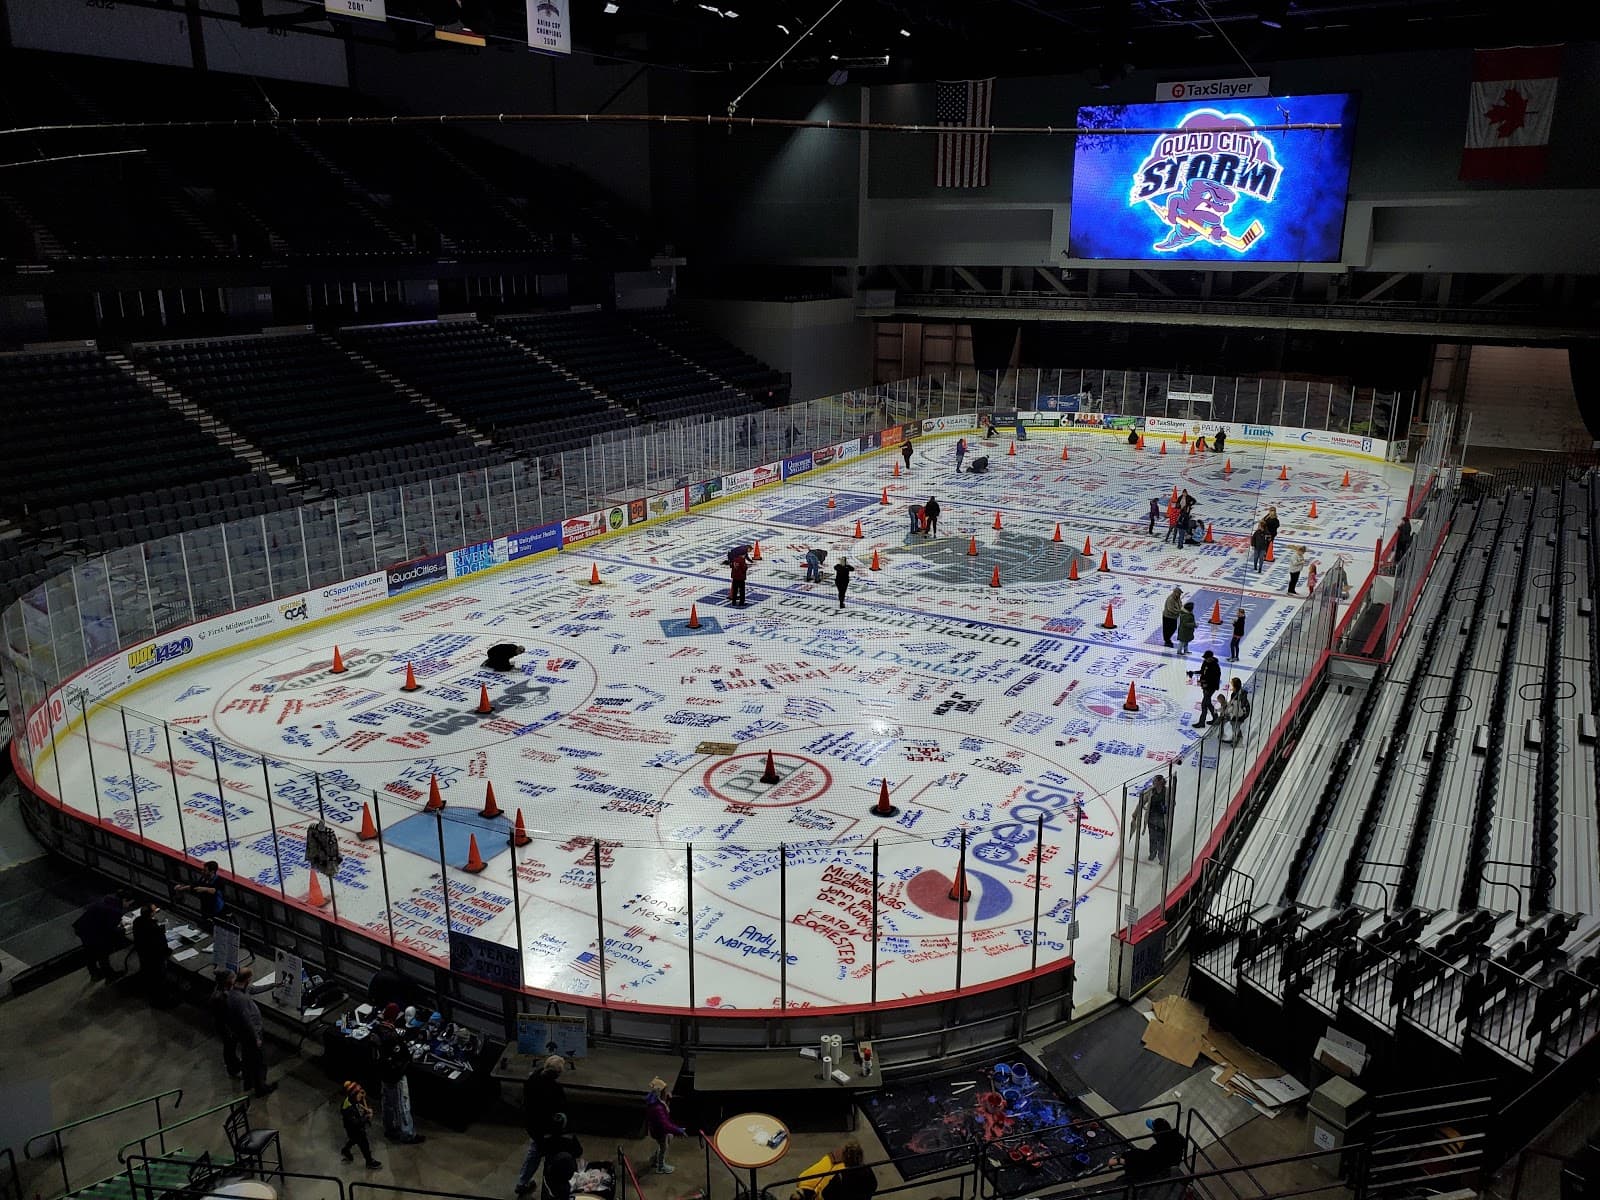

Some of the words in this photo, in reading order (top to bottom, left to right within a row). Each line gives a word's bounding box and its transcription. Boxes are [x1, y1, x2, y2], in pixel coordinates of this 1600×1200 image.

[1187, 82, 1252, 98] TaxSlayer
[1162, 133, 1213, 156] QUAD
[1219, 133, 1260, 162] CITY
[1138, 154, 1278, 198] STORM
[1201, 424, 1231, 435] PALMER
[1241, 425, 1275, 438] Times
[756, 606, 830, 628] Trinity
[774, 597, 922, 631] UnityPoint
[922, 623, 1022, 648] Health
[869, 649, 975, 679] Dental
[322, 769, 360, 792] BRAD
[972, 780, 1077, 873] pepsi
[398, 901, 433, 919] ELDON
[413, 897, 443, 913] EARL
[455, 902, 497, 921] MENKEN
[464, 896, 506, 914] MENKEN
[805, 907, 860, 937] KEATON
[401, 934, 438, 954] WEST
[738, 925, 777, 950] Andy
[792, 914, 856, 966] ROCHESTER
[714, 935, 799, 966] Marquette
